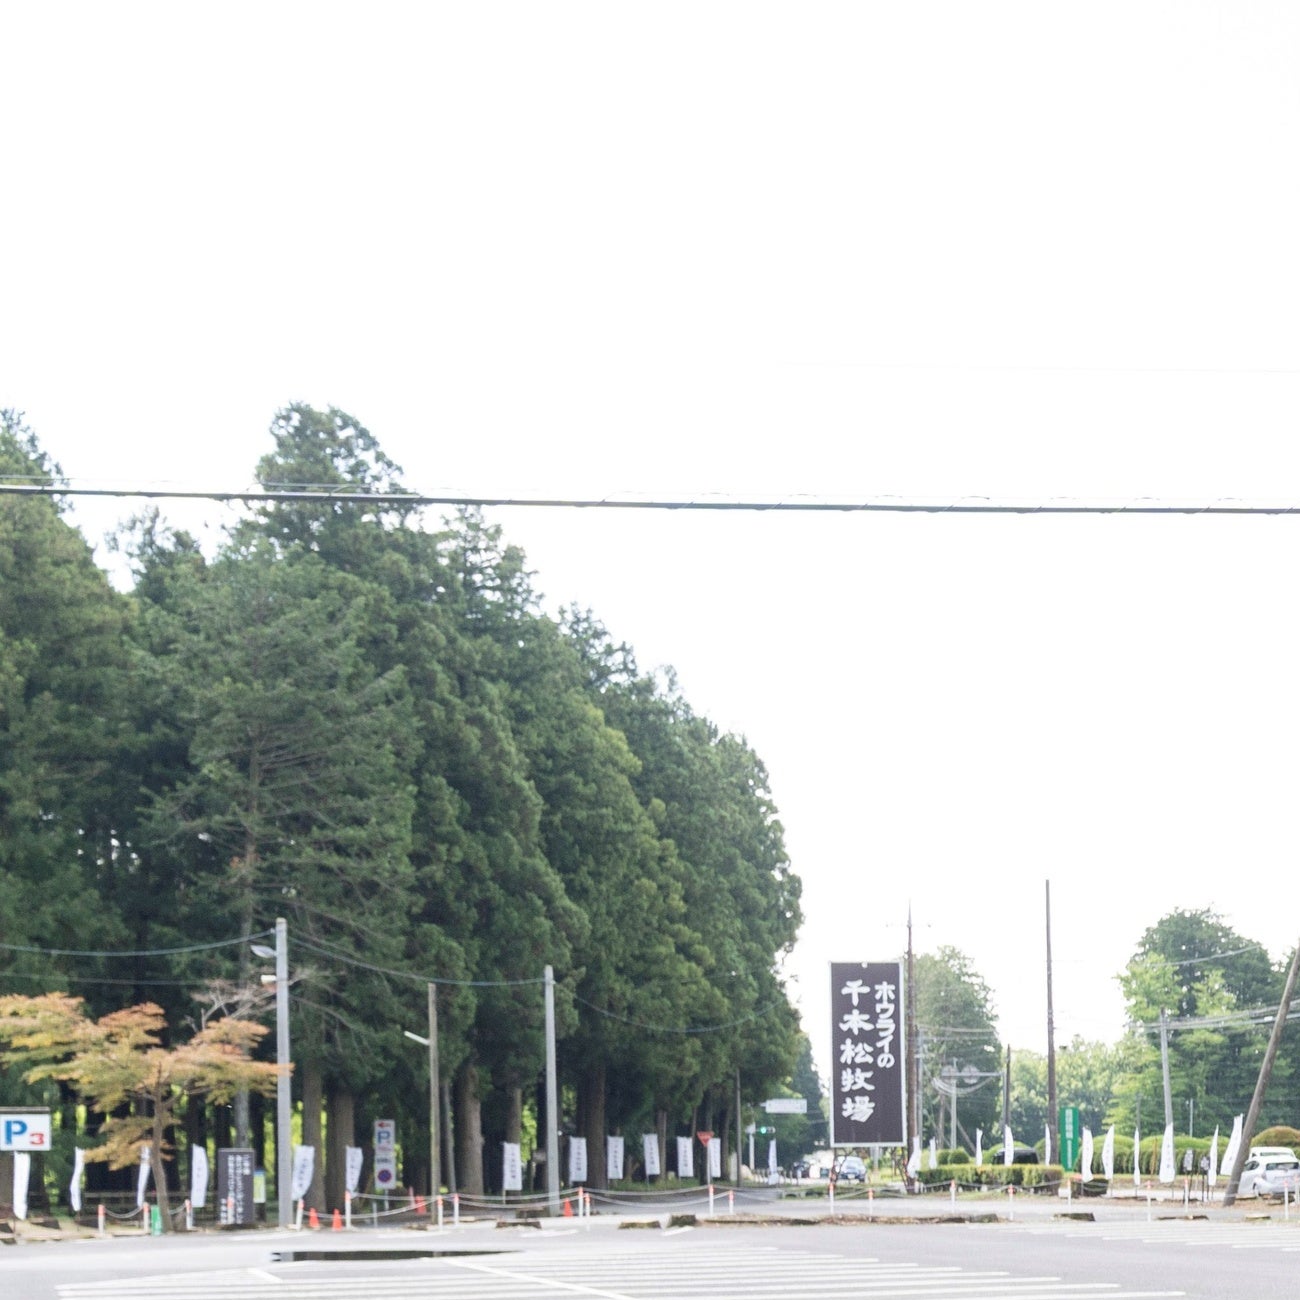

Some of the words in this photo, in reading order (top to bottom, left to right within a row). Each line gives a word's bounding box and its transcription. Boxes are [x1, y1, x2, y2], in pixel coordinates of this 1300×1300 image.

[838, 979, 876, 1123] 千本松牧場
[874, 981, 896, 1069] ホウライの
